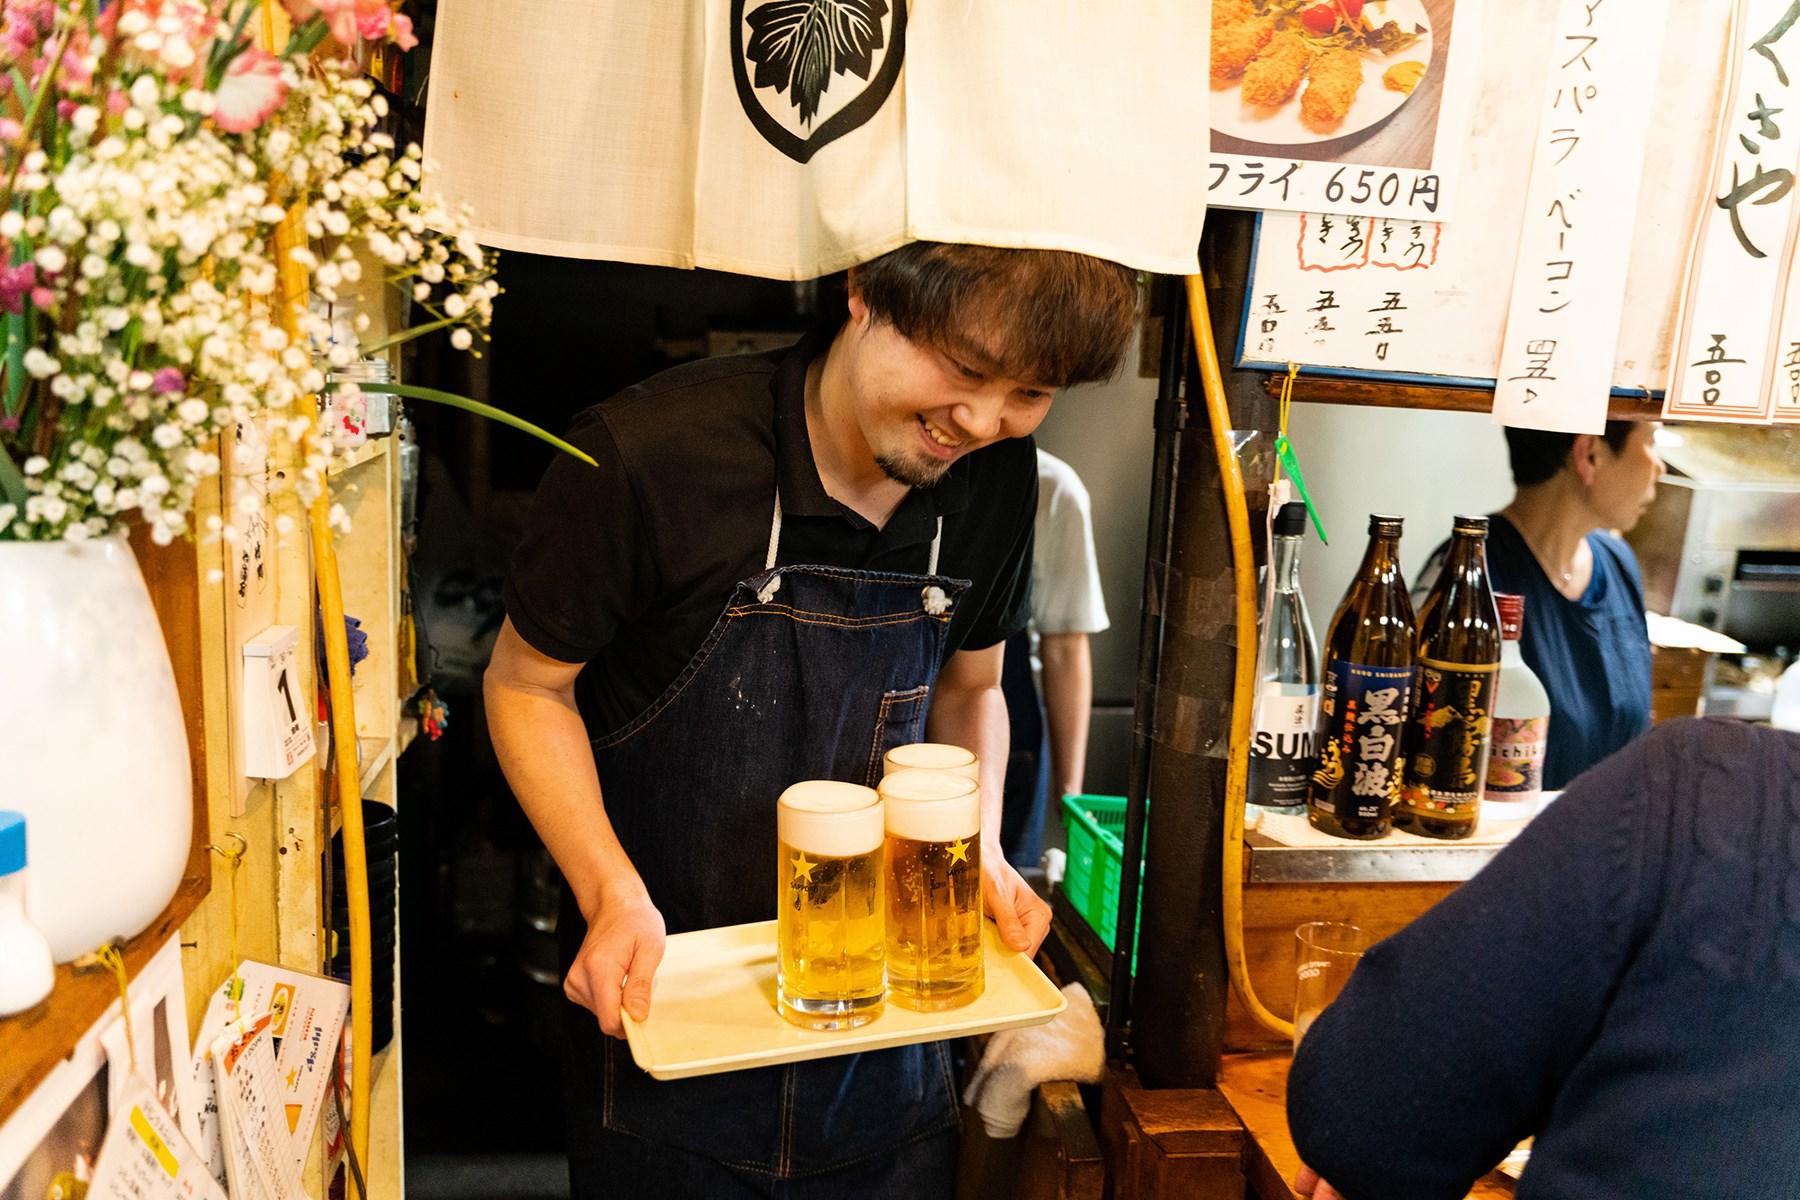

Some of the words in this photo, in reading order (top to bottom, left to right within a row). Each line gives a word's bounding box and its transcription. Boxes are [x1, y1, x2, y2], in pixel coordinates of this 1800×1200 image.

[1716, 0, 1800, 259] くさや
[1208, 162, 1301, 202] フライ
[1325, 166, 1440, 213] 650円
[1351, 687, 1401, 798] 黒白波
